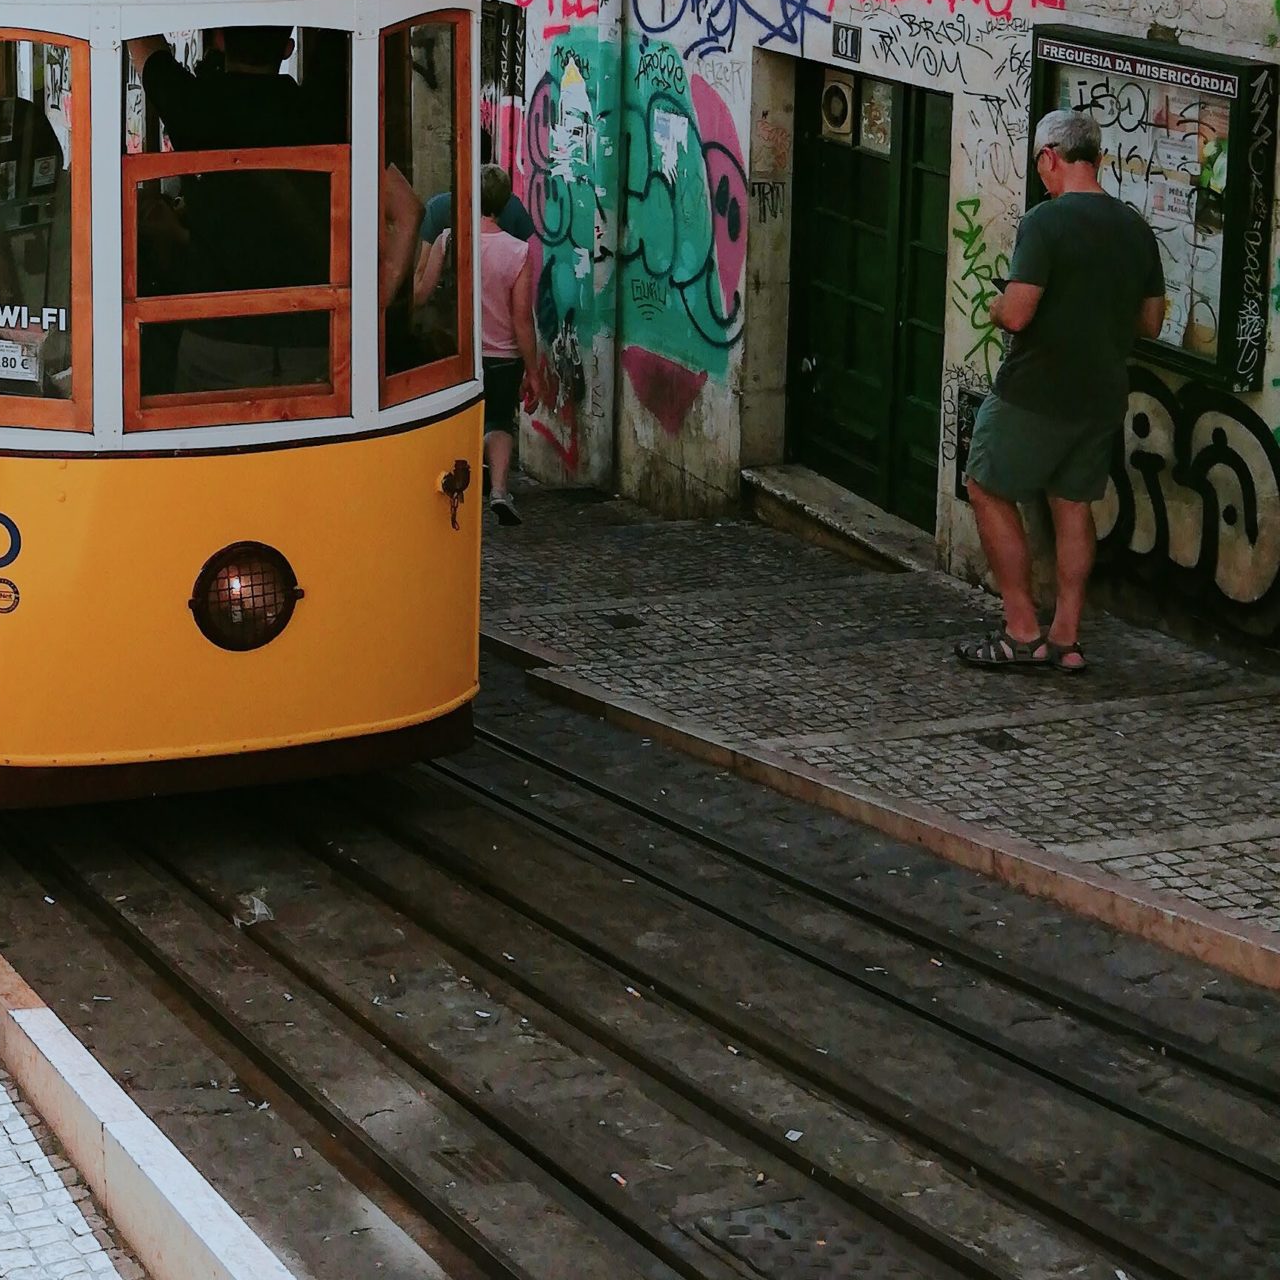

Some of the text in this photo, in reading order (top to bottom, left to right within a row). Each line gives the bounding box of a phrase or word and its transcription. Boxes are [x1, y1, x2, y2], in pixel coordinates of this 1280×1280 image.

[1042, 44, 1236, 95] FREGUESIA DA MISERICÓRDIA
[20, 358, 30, 370] €
